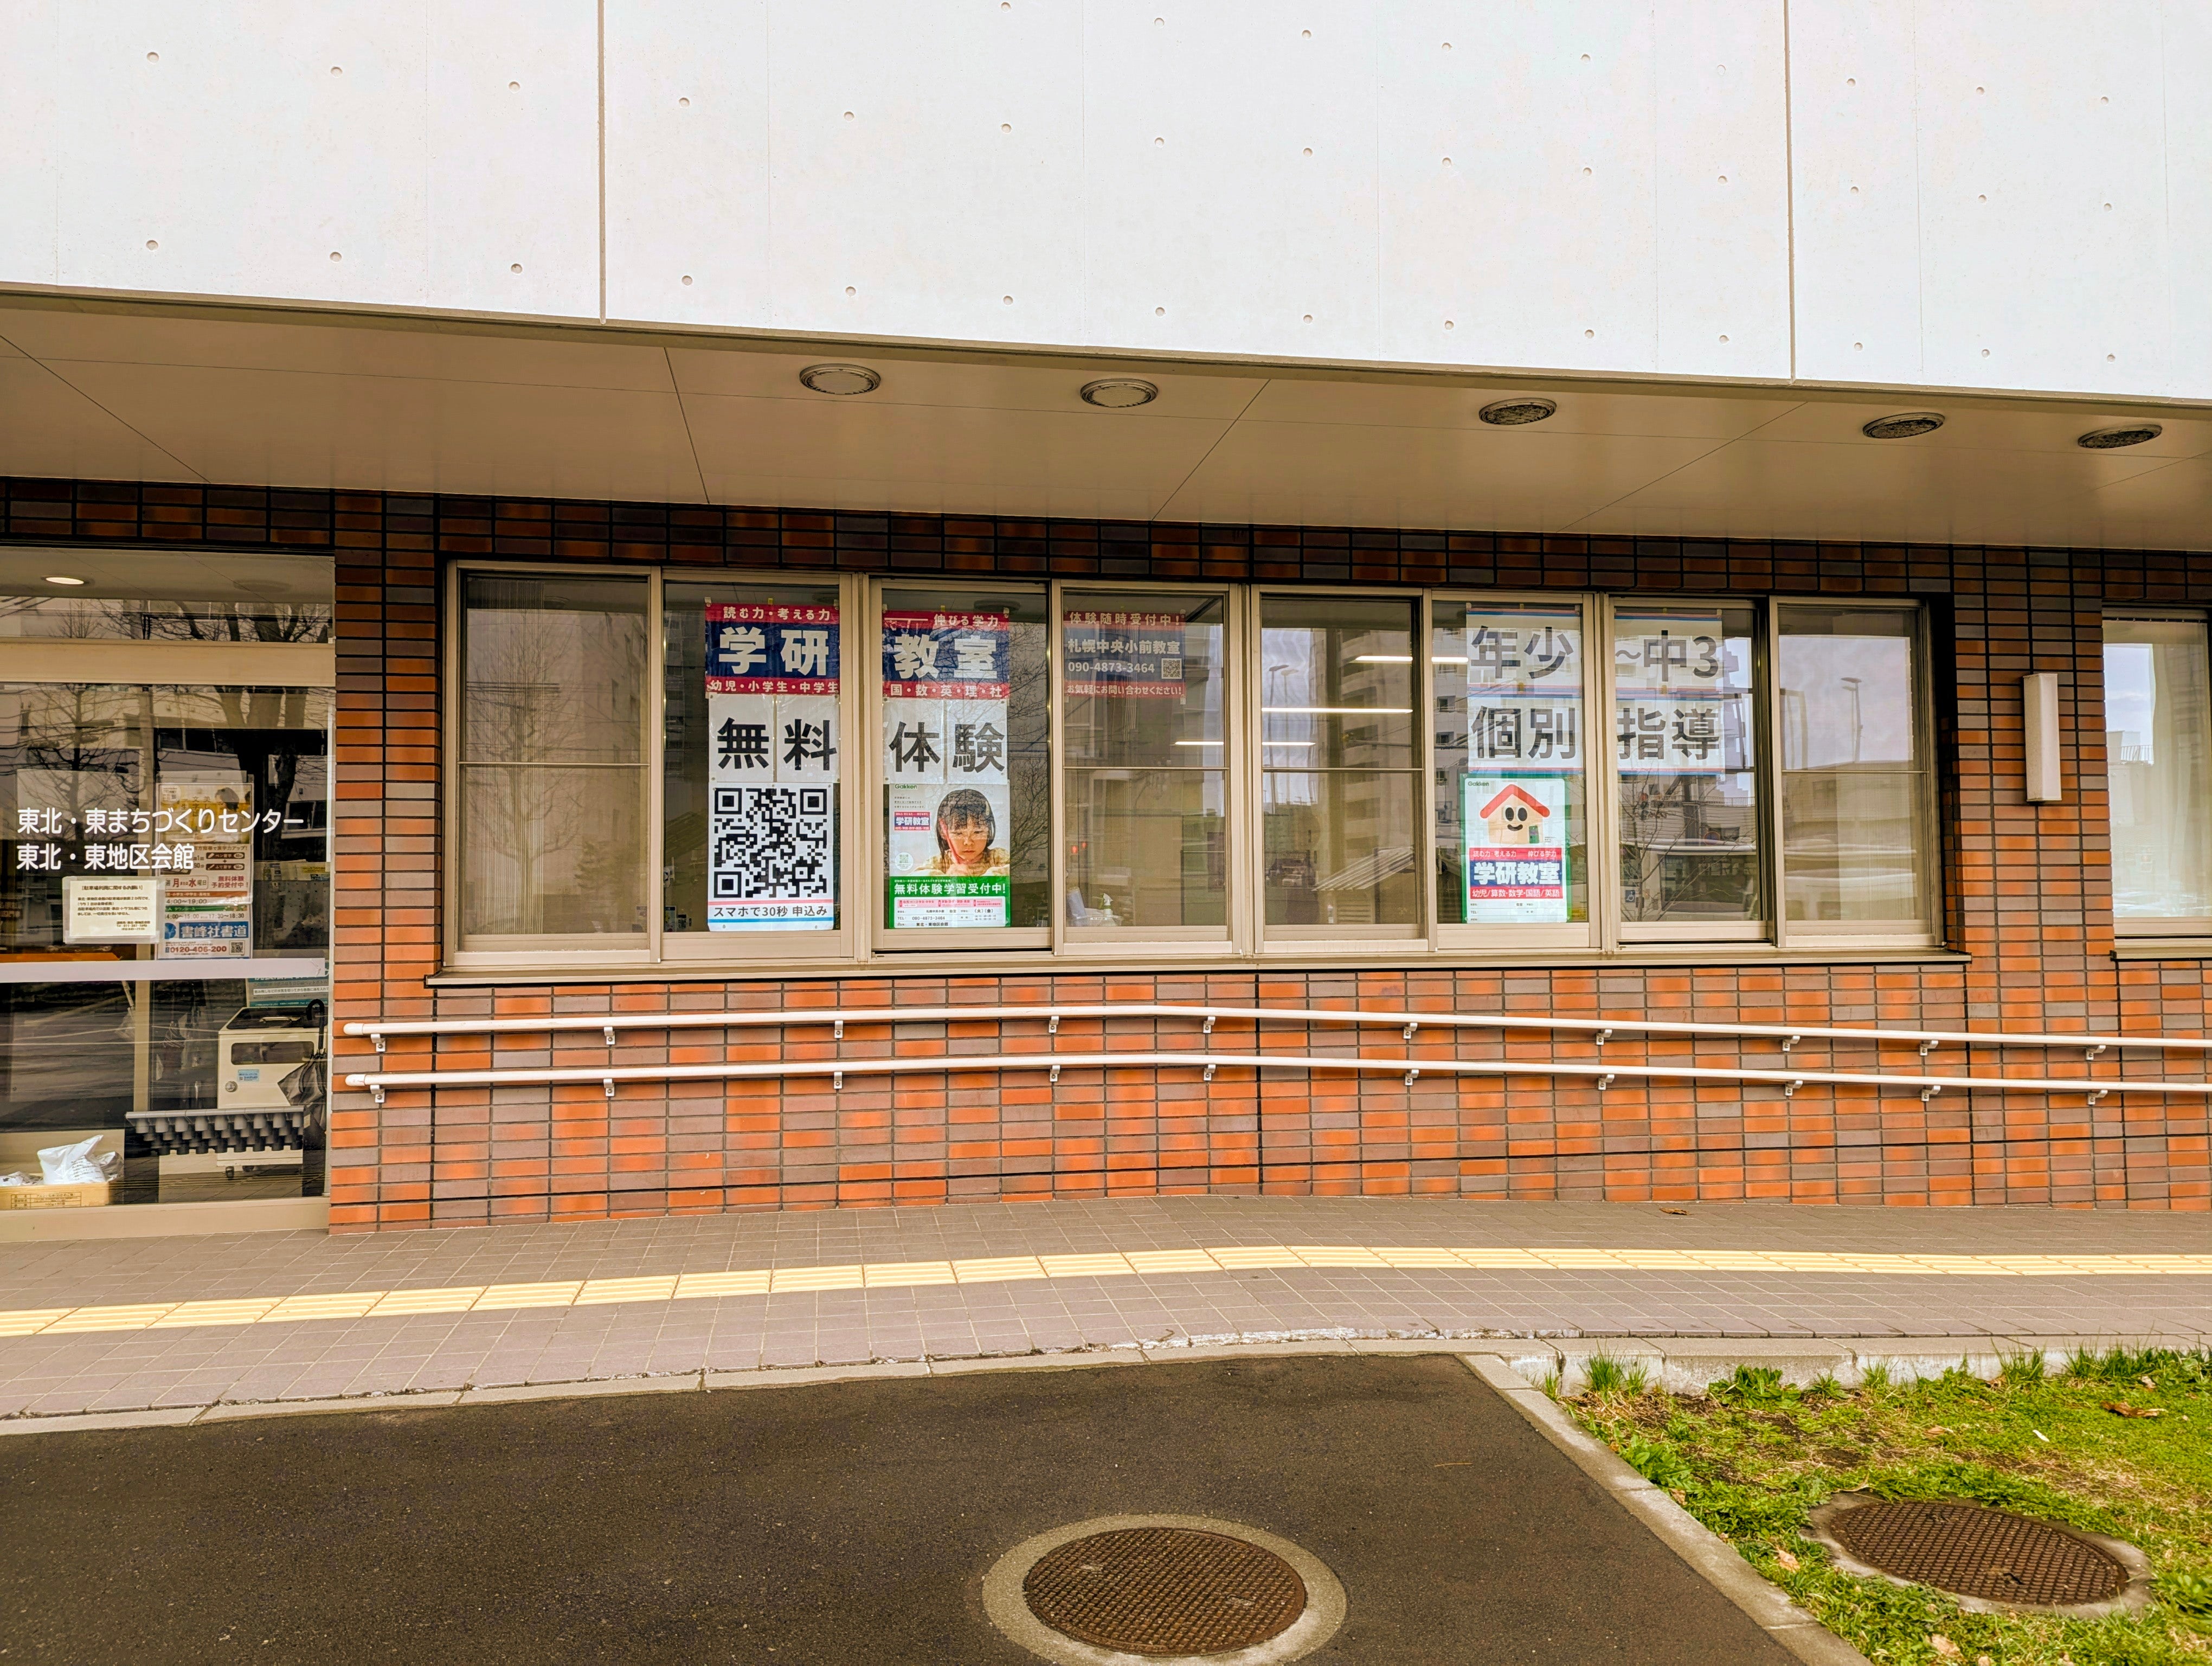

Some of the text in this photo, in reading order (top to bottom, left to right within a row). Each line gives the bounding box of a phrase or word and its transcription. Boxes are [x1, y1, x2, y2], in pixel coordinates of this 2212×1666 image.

[723, 606, 831, 621] 読む力・考える力
[934, 613, 999, 627] 伸びる学力
[718, 626, 829, 676] 学研
[893, 633, 998, 680] 教室
[1068, 638, 1181, 655] 札幌中央小前教室
[1470, 625, 1574, 680] 年少
[1068, 661, 1155, 674] 090-4873-3464
[710, 680, 839, 694] 幼児・小学生・中学生
[890, 684, 1002, 699] 国・数・英・理・社
[1470, 706, 1576, 759] 個別
[1616, 707, 1720, 760] 指導
[717, 717, 838, 771] 無料
[889, 721, 1006, 773] 体験
[17, 807, 304, 835] 東北・東まちづくりセンター
[896, 817, 929, 826] 学研教室
[16, 843, 195, 870] 東北・東地区会館
[1474, 861, 1561, 886] 学研教室
[894, 883, 1006, 895] 無料体験学習受付中!
[713, 905, 827, 918] スマホで30秒 申込み
[181, 925, 247, 938] 書峰社書道
